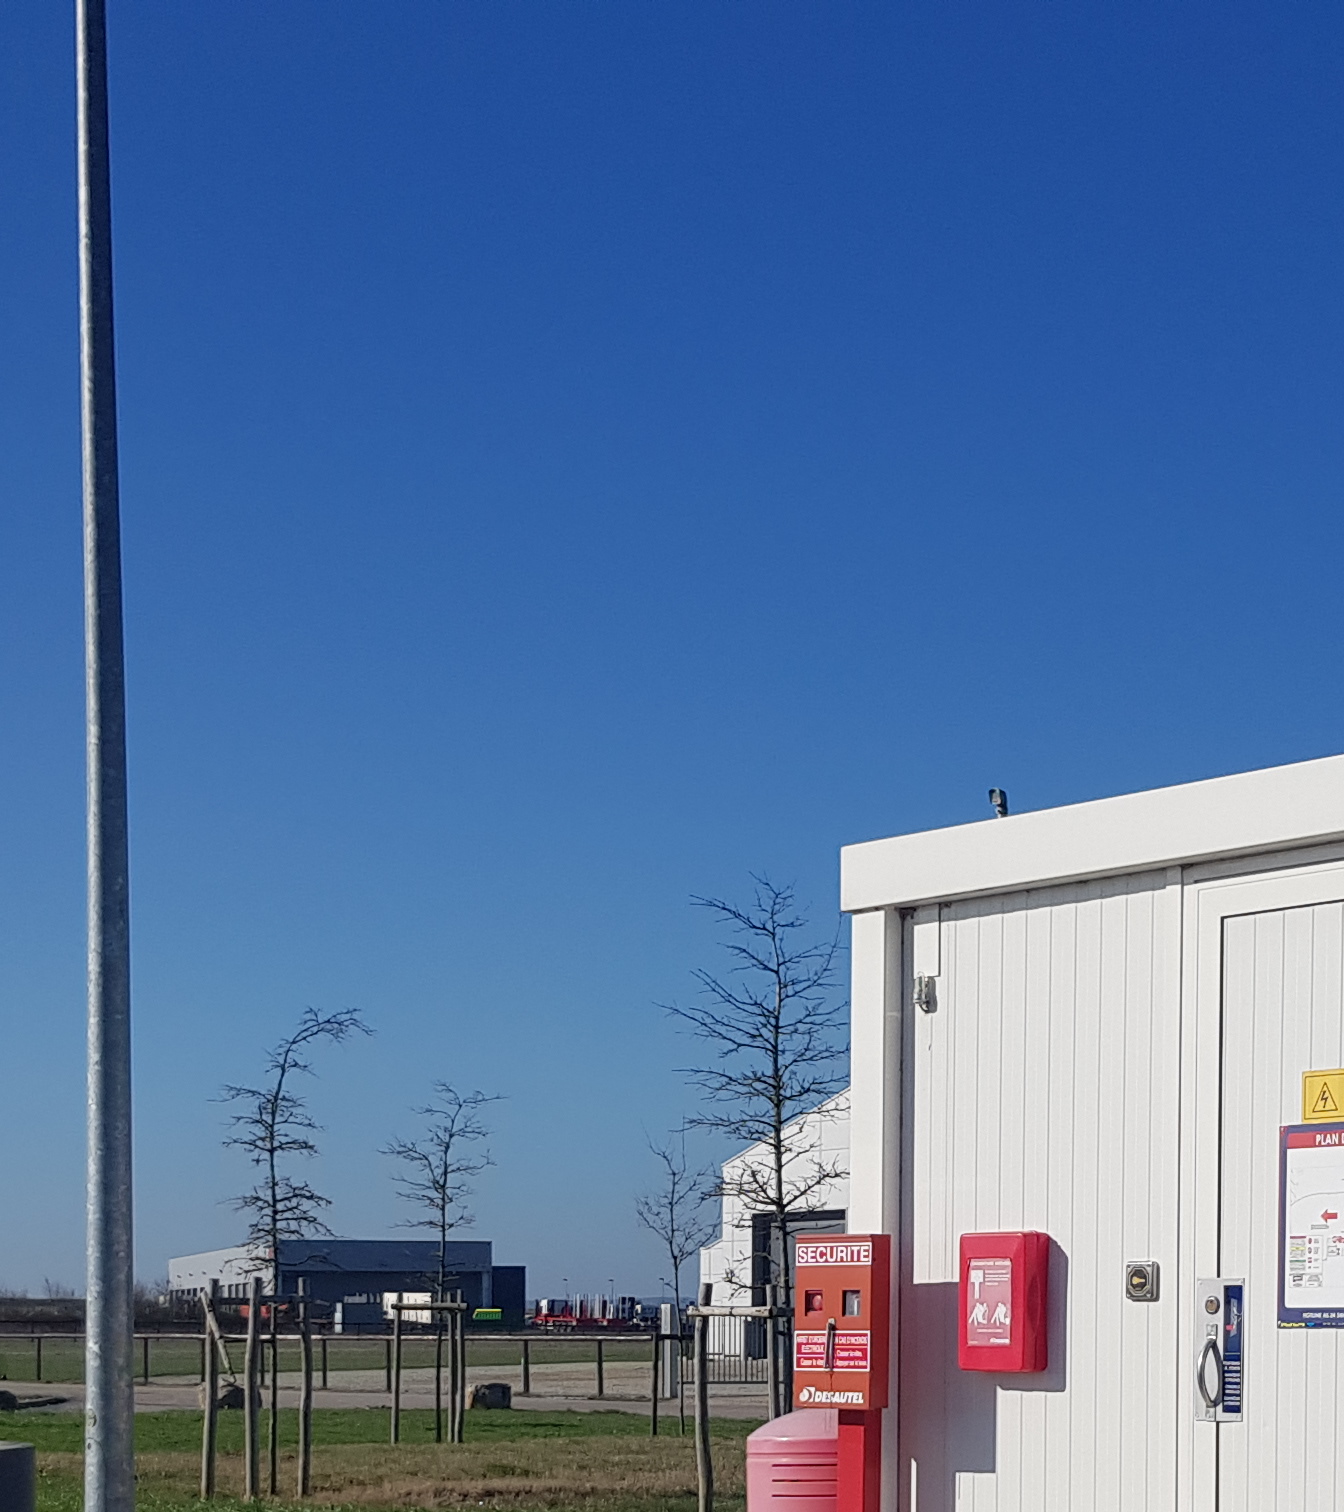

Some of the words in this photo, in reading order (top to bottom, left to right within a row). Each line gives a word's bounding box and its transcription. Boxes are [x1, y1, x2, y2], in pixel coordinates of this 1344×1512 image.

[1316, 1134, 1339, 1146] PLAN
[798, 1246, 870, 1263] SECURITE
[814, 1390, 864, 1404] DESAUTEL
